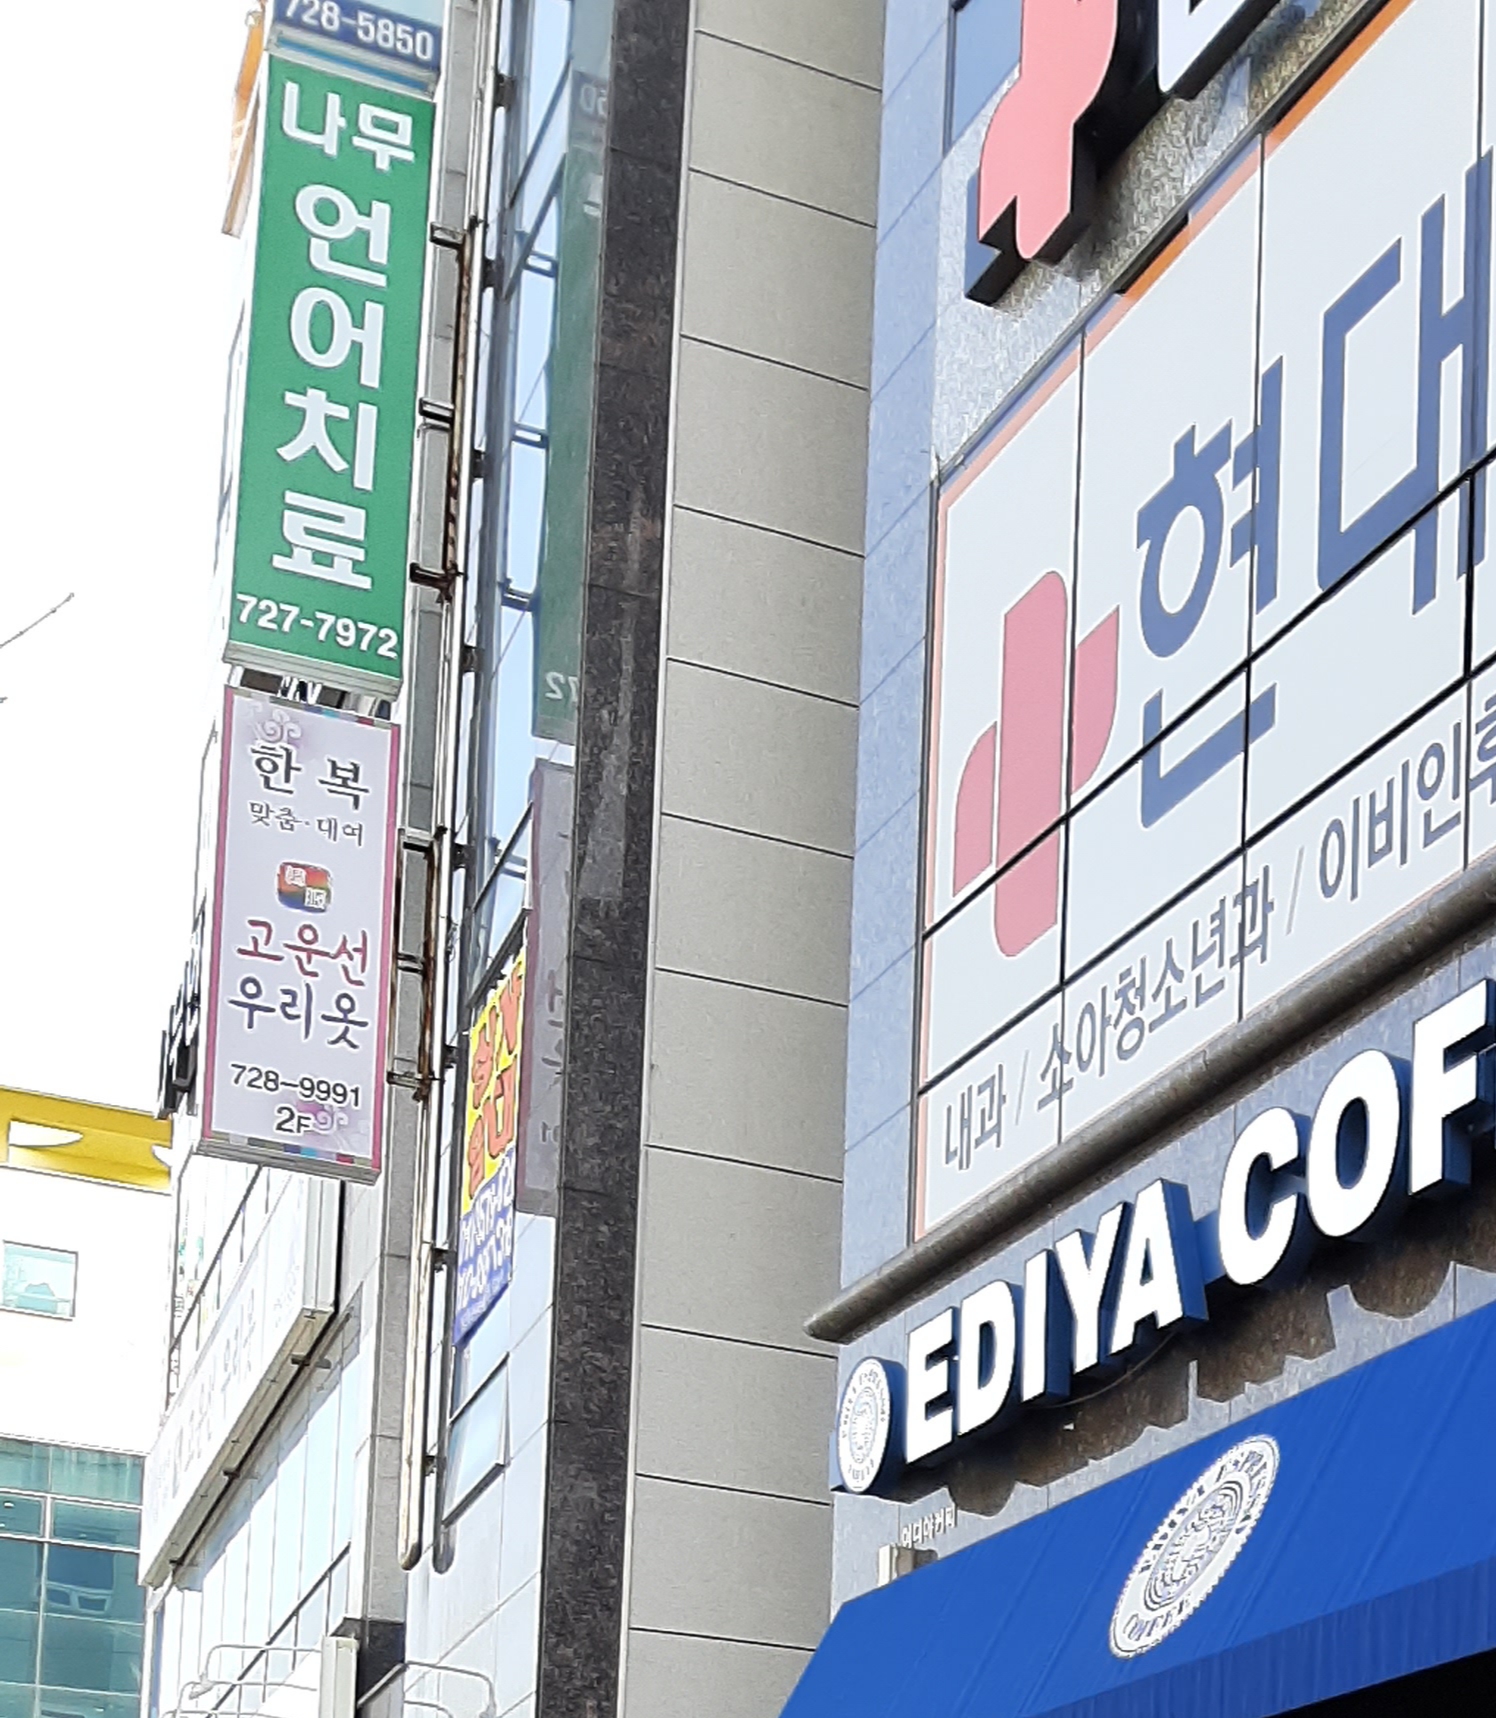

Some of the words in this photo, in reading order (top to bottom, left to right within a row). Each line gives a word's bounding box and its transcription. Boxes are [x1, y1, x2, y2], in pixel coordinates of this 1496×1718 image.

[281, 81, 416, 172] 나무
[271, 183, 391, 593] 언어치료
[236, 592, 400, 661] 727-7972
[236, 918, 369, 987] 고운선
[228, 975, 370, 1050] 우리옷
[944, 1062, 1006, 1172] 내과
[1037, 862, 1275, 1107] 소아청소년과
[229, 1063, 362, 1108] 728-9991
[274, 1106, 313, 1134] 2F
[904, 1177, 1186, 1465] EDIYA
